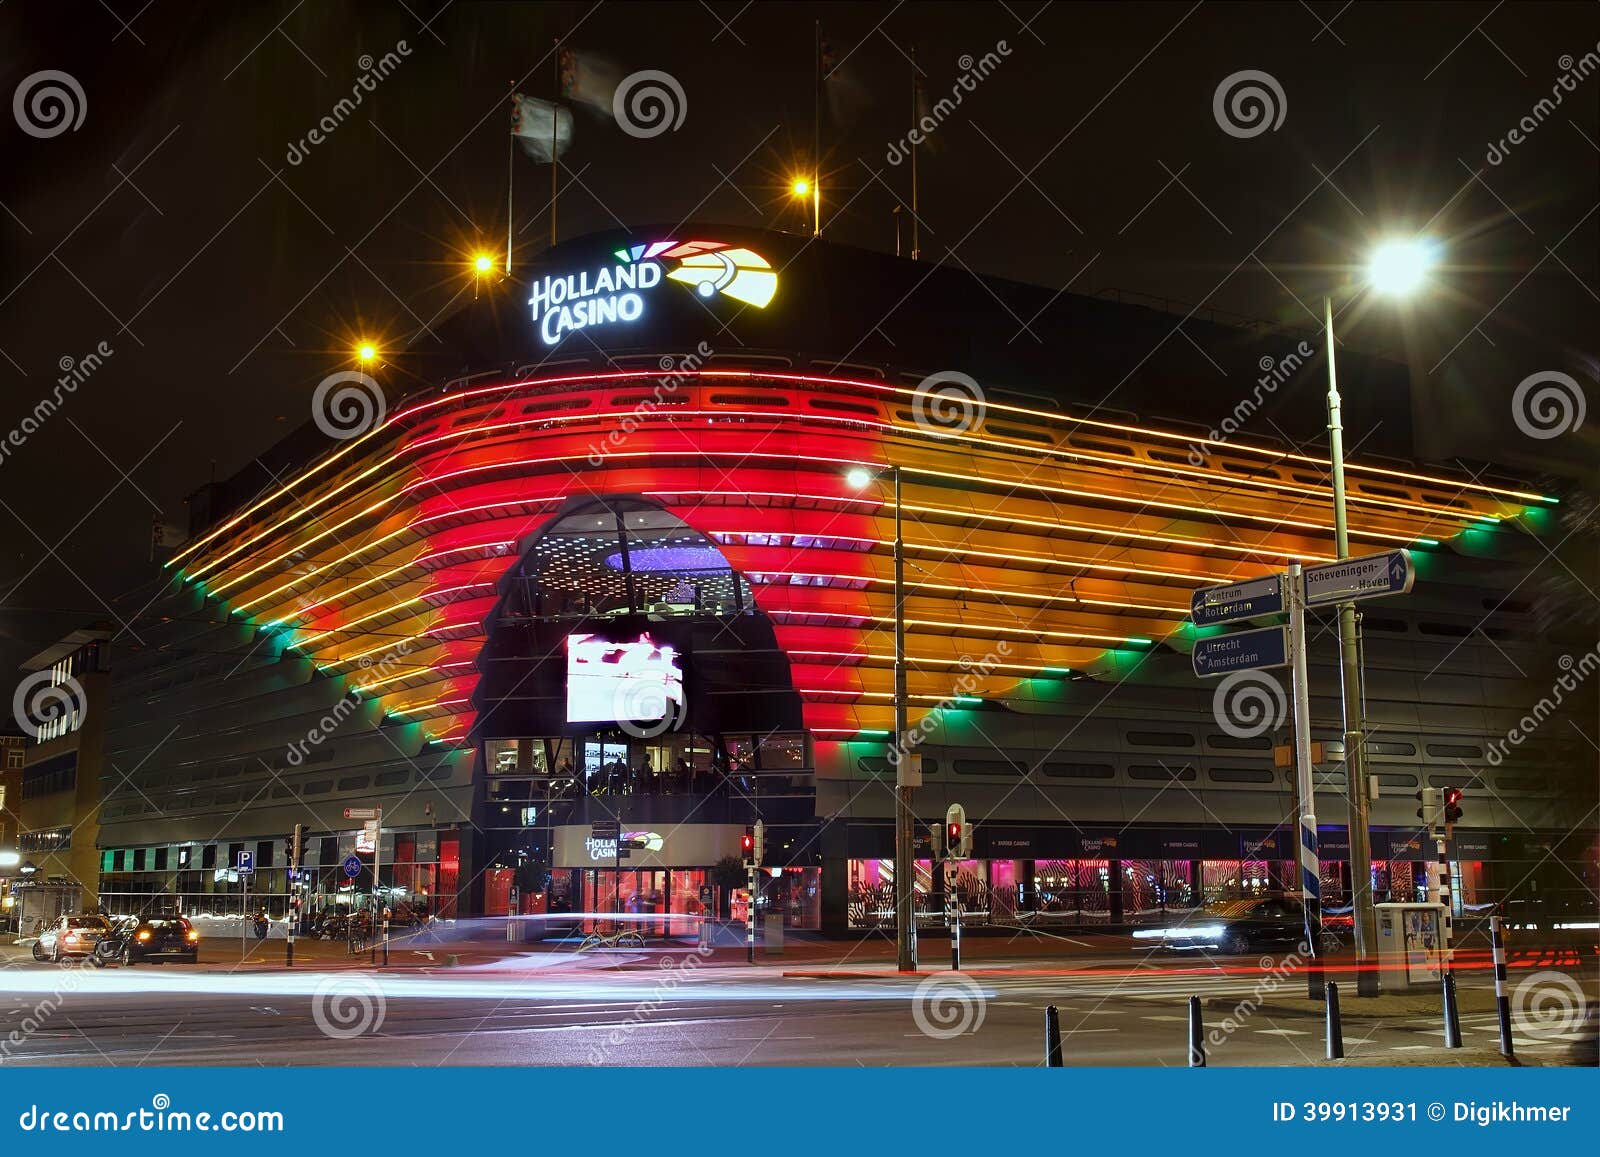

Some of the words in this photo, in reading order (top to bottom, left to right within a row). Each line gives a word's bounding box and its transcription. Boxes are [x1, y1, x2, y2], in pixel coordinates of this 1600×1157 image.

[528, 262, 661, 321] HOLLAND
[541, 293, 644, 345] CASINO
[1308, 564, 1378, 582] Scheveningen-
[1359, 576, 1389, 589] Haven
[1206, 589, 1242, 602] entrum
[1205, 602, 1252, 617] Rotterdam
[1206, 639, 1240, 653] Utrecht
[1207, 653, 1259, 668] Amsterdam
[585, 837, 617, 851] HOLLA
[241, 853, 250, 864] P
[590, 847, 617, 860] CASIN
